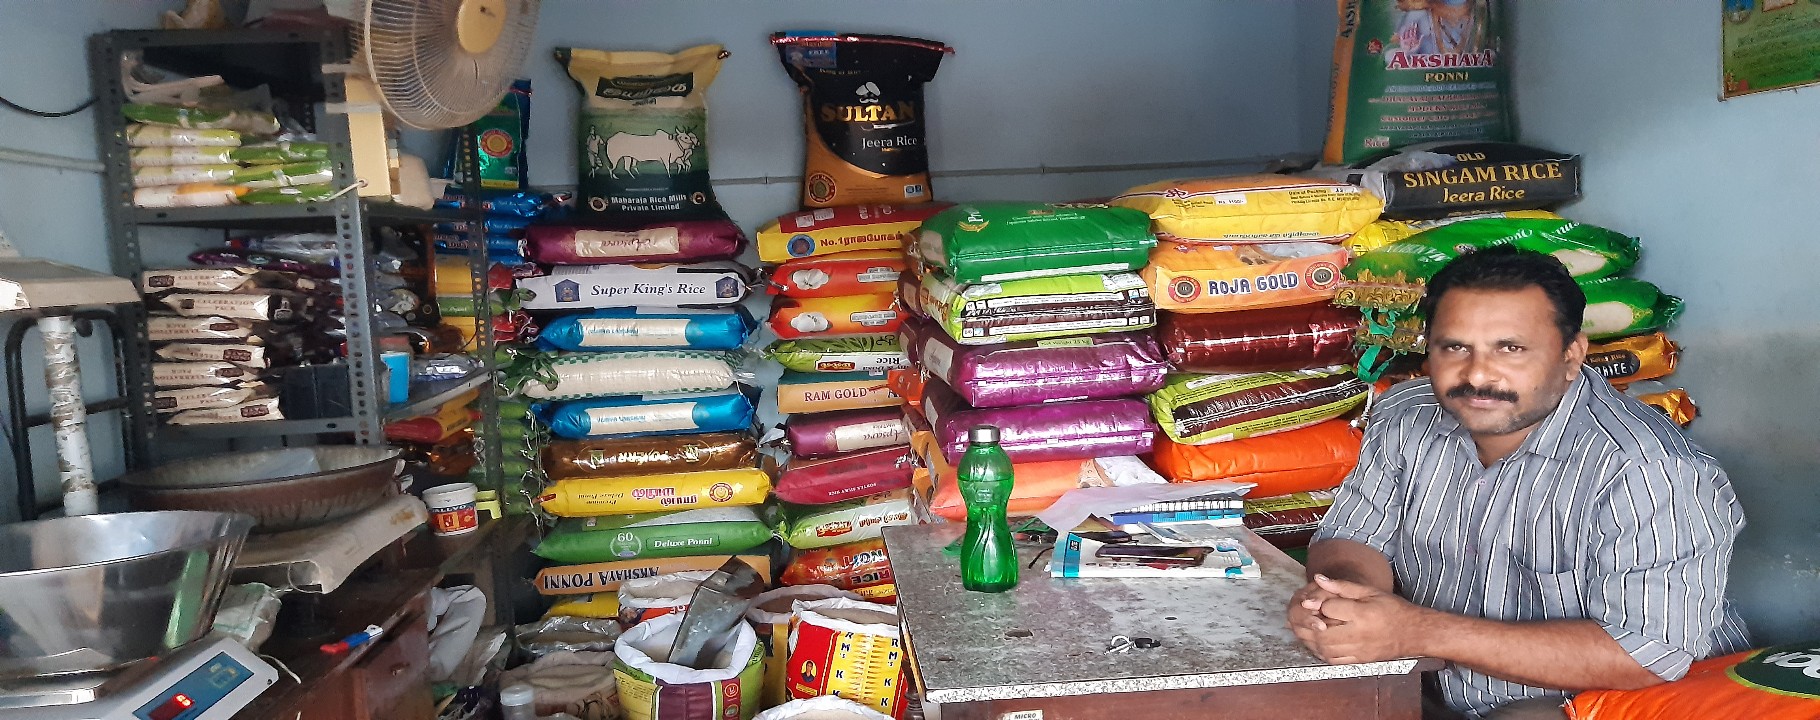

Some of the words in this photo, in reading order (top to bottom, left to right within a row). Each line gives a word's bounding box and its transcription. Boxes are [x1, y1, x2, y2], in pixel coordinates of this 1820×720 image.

[1387, 49, 1494, 69] AKSHAYA
[1424, 72, 1469, 82] PONNI
[820, 101, 915, 122] SULTAN
[861, 136, 893, 150] Jeera
[896, 135, 918, 147] Rice
[1456, 151, 1486, 162] OLD
[1403, 165, 1497, 189] SINGAM
[1502, 161, 1563, 181] RICE
[610, 195, 648, 205] Maharaja
[649, 195, 667, 204] Rice
[668, 194, 688, 203] Mills
[1443, 186, 1486, 204] Jeera
[1489, 186, 1526, 202] Rice
[621, 203, 649, 212] Private
[650, 202, 681, 211] Limited
[590, 283, 630, 297] Super
[632, 282, 673, 297] King's
[676, 282, 707, 295] Rice
[1208, 276, 1250, 297] ROJA
[1256, 271, 1300, 292] GOLD
[804, 388, 831, 402] RAM
[834, 386, 867, 399] GOLD
[617, 532, 634, 543] 60
[653, 538, 685, 549] Deluxe
[687, 537, 713, 547] Ponni
[544, 572, 594, 590] PONNI
[597, 566, 660, 586] AKSHAYA
[849, 568, 891, 586] RICE
[1014, 712, 1037, 720] MICRO
